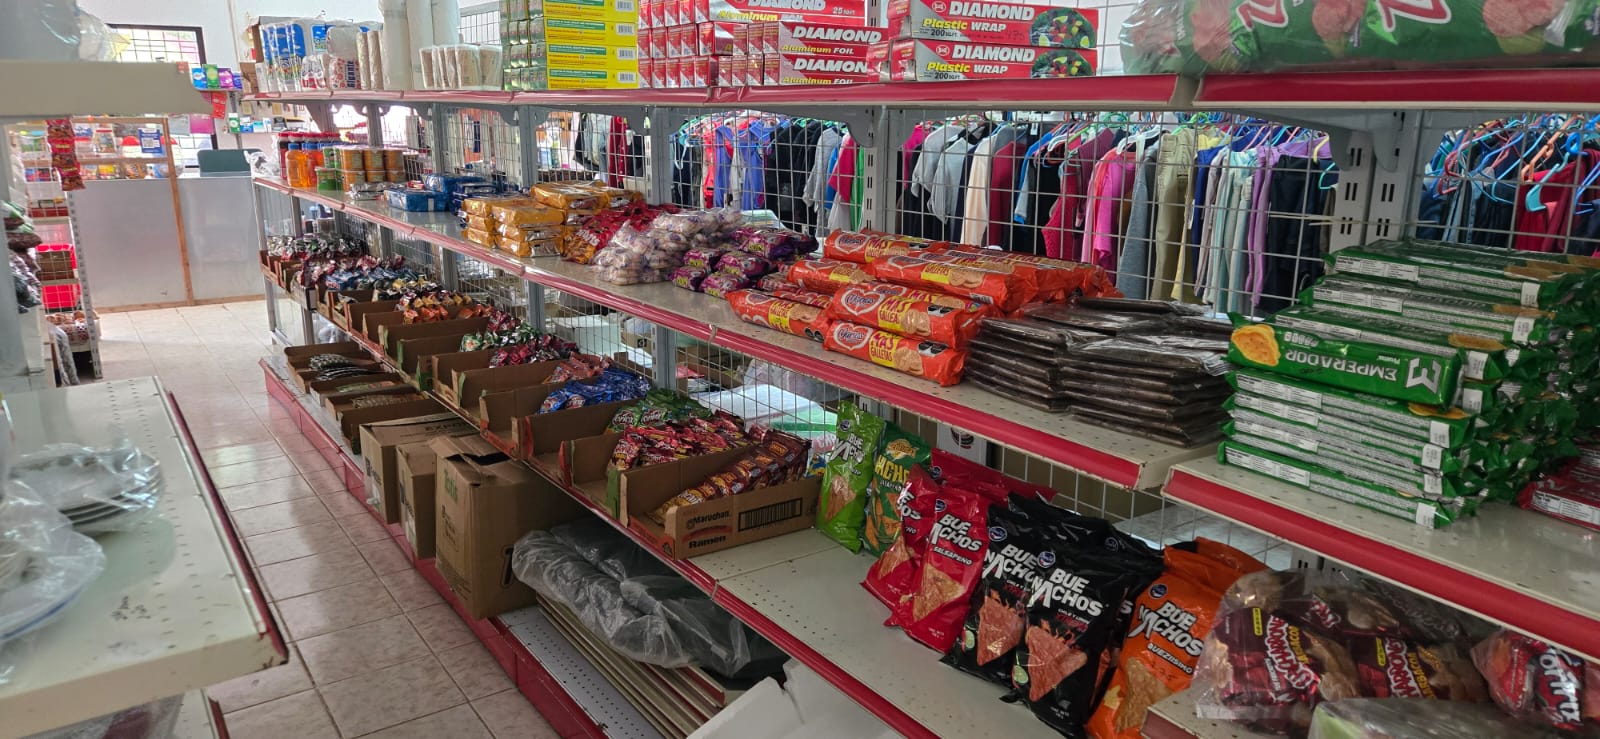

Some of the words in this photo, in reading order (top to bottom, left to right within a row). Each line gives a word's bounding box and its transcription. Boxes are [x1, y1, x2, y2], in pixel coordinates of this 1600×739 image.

[719, 10, 778, 21] Aluminum
[949, 2, 1035, 20] DIAMOND
[923, 18, 968, 29] Plastic
[971, 22, 1007, 32] WRAP
[930, 29, 946, 37] 200
[792, 26, 882, 44] DIAMOND
[782, 45, 832, 54] Aluminum
[833, 47, 854, 55] FOIL
[952, 45, 1036, 62] DIAMOND
[793, 58, 868, 73] DIAMON
[927, 62, 971, 73] Plastic
[973, 64, 1009, 74] WRAP
[934, 72, 949, 80] 200
[882, 299, 908, 313] MAS
[873, 334, 894, 350] MAS
[1285, 349, 1398, 382] EMPERADOR
[694, 510, 730, 523] Maruchan
[939, 513, 972, 536] BUE
[688, 535, 726, 549] Ramen
[1001, 544, 1037, 570] BUE
[1049, 568, 1090, 595] BUE
[1027, 575, 1104, 617] NACHOS
[1156, 601, 1197, 631] BUE
[1128, 604, 1204, 656] NACHOS
